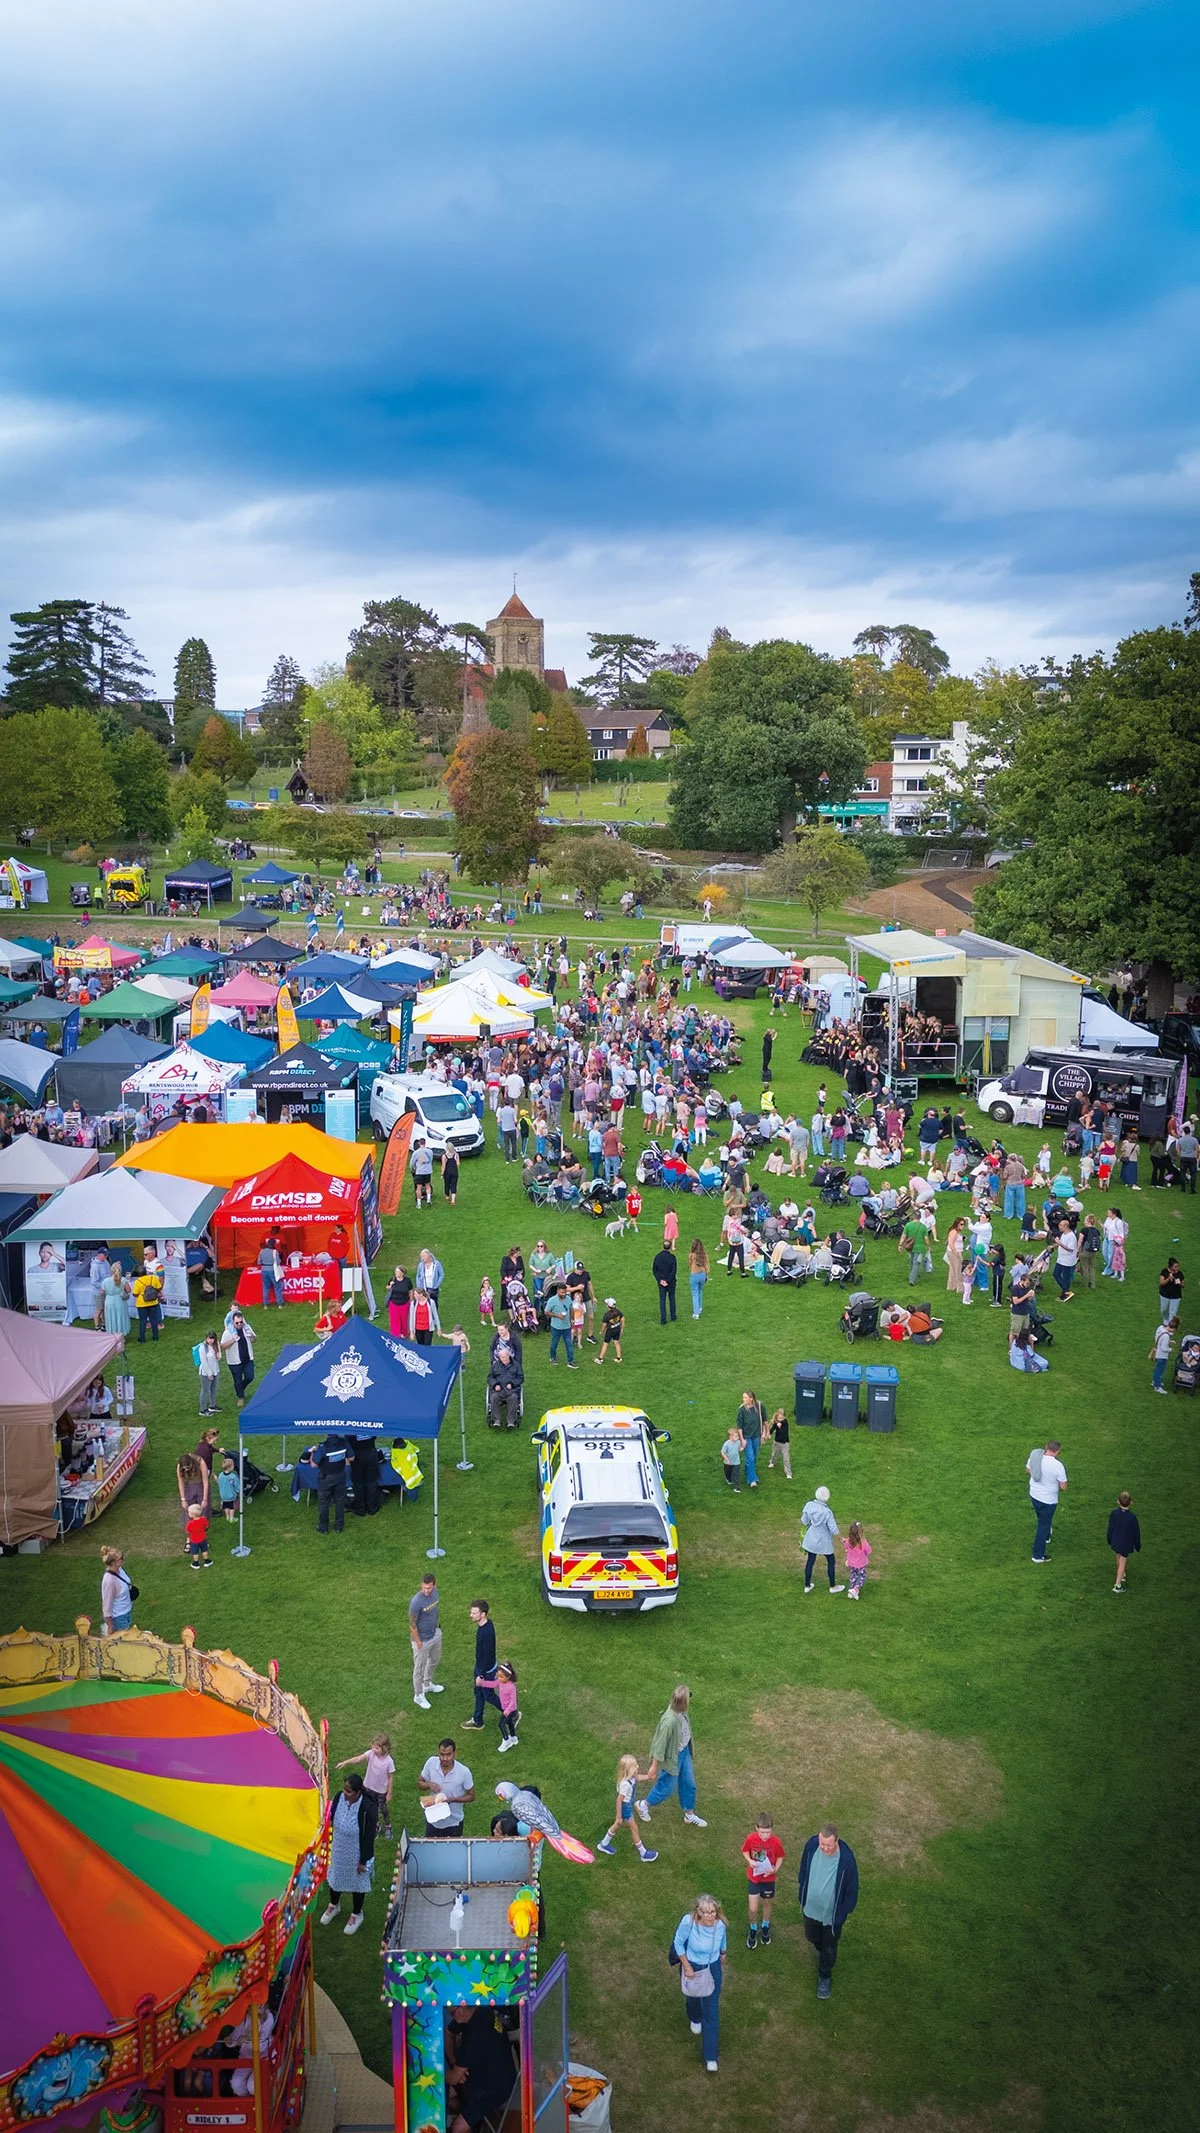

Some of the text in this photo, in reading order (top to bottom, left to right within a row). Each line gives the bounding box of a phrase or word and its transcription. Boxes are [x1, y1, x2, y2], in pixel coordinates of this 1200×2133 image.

[1060, 1073, 1087, 1083] VILLAGE
[252, 1082, 328, 1090] www.rbpmdirect.co.uk
[1058, 1080, 1085, 1089] CHIPPY
[282, 1104, 309, 1114] BPM
[1046, 1103, 1068, 1112] TRADI
[1118, 1113, 1140, 1121] CHIPS
[251, 1192, 306, 1207] DKMS
[230, 1215, 265, 1223] Become
[314, 1213, 339, 1221] donor
[283, 1277, 313, 1290] KMS
[294, 1420, 384, 1429] WWW.SUSSEX.POLICE.UK
[584, 1441, 626, 1451] 985
[596, 1590, 615, 1598] LJ24
